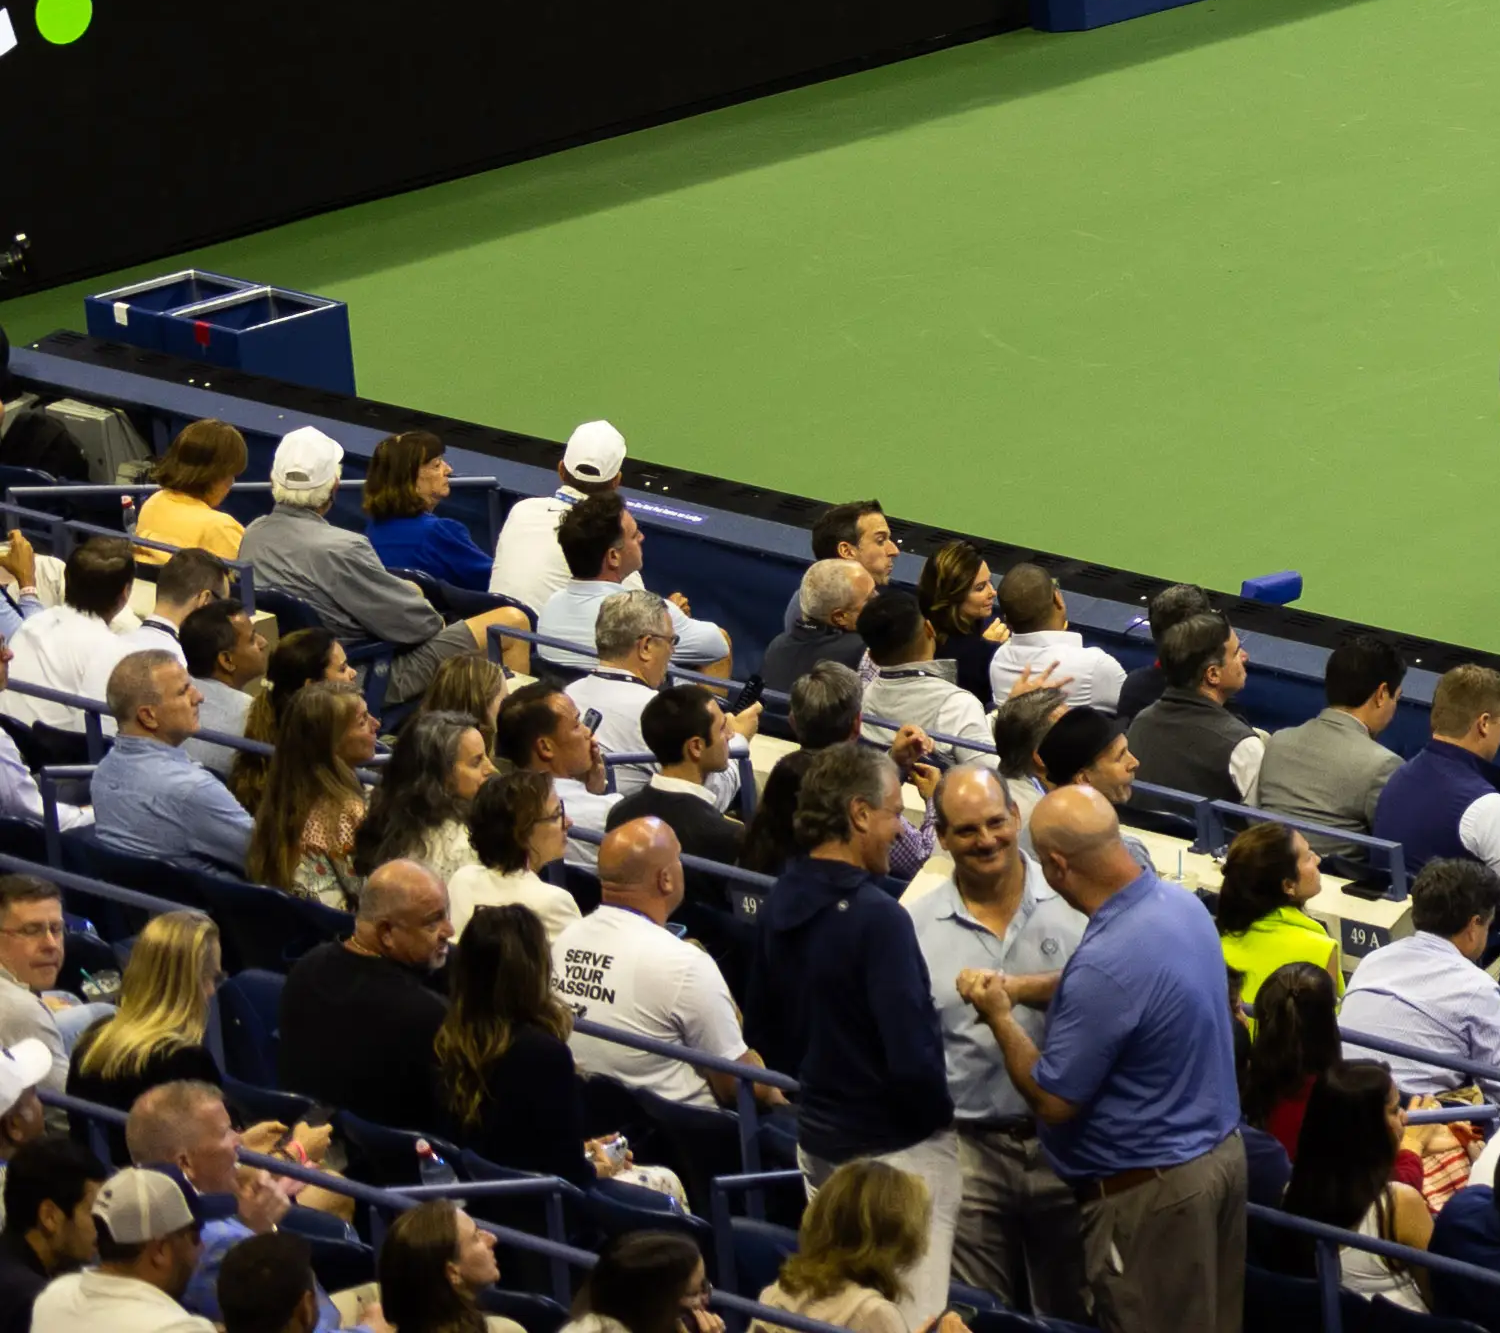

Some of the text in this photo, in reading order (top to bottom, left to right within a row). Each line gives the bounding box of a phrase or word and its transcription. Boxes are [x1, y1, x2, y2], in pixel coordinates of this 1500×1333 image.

[742, 896, 757, 914] 49
[1350, 927, 1383, 949] 49 A
[564, 949, 614, 971] SERVE
[564, 964, 604, 984] YOUR
